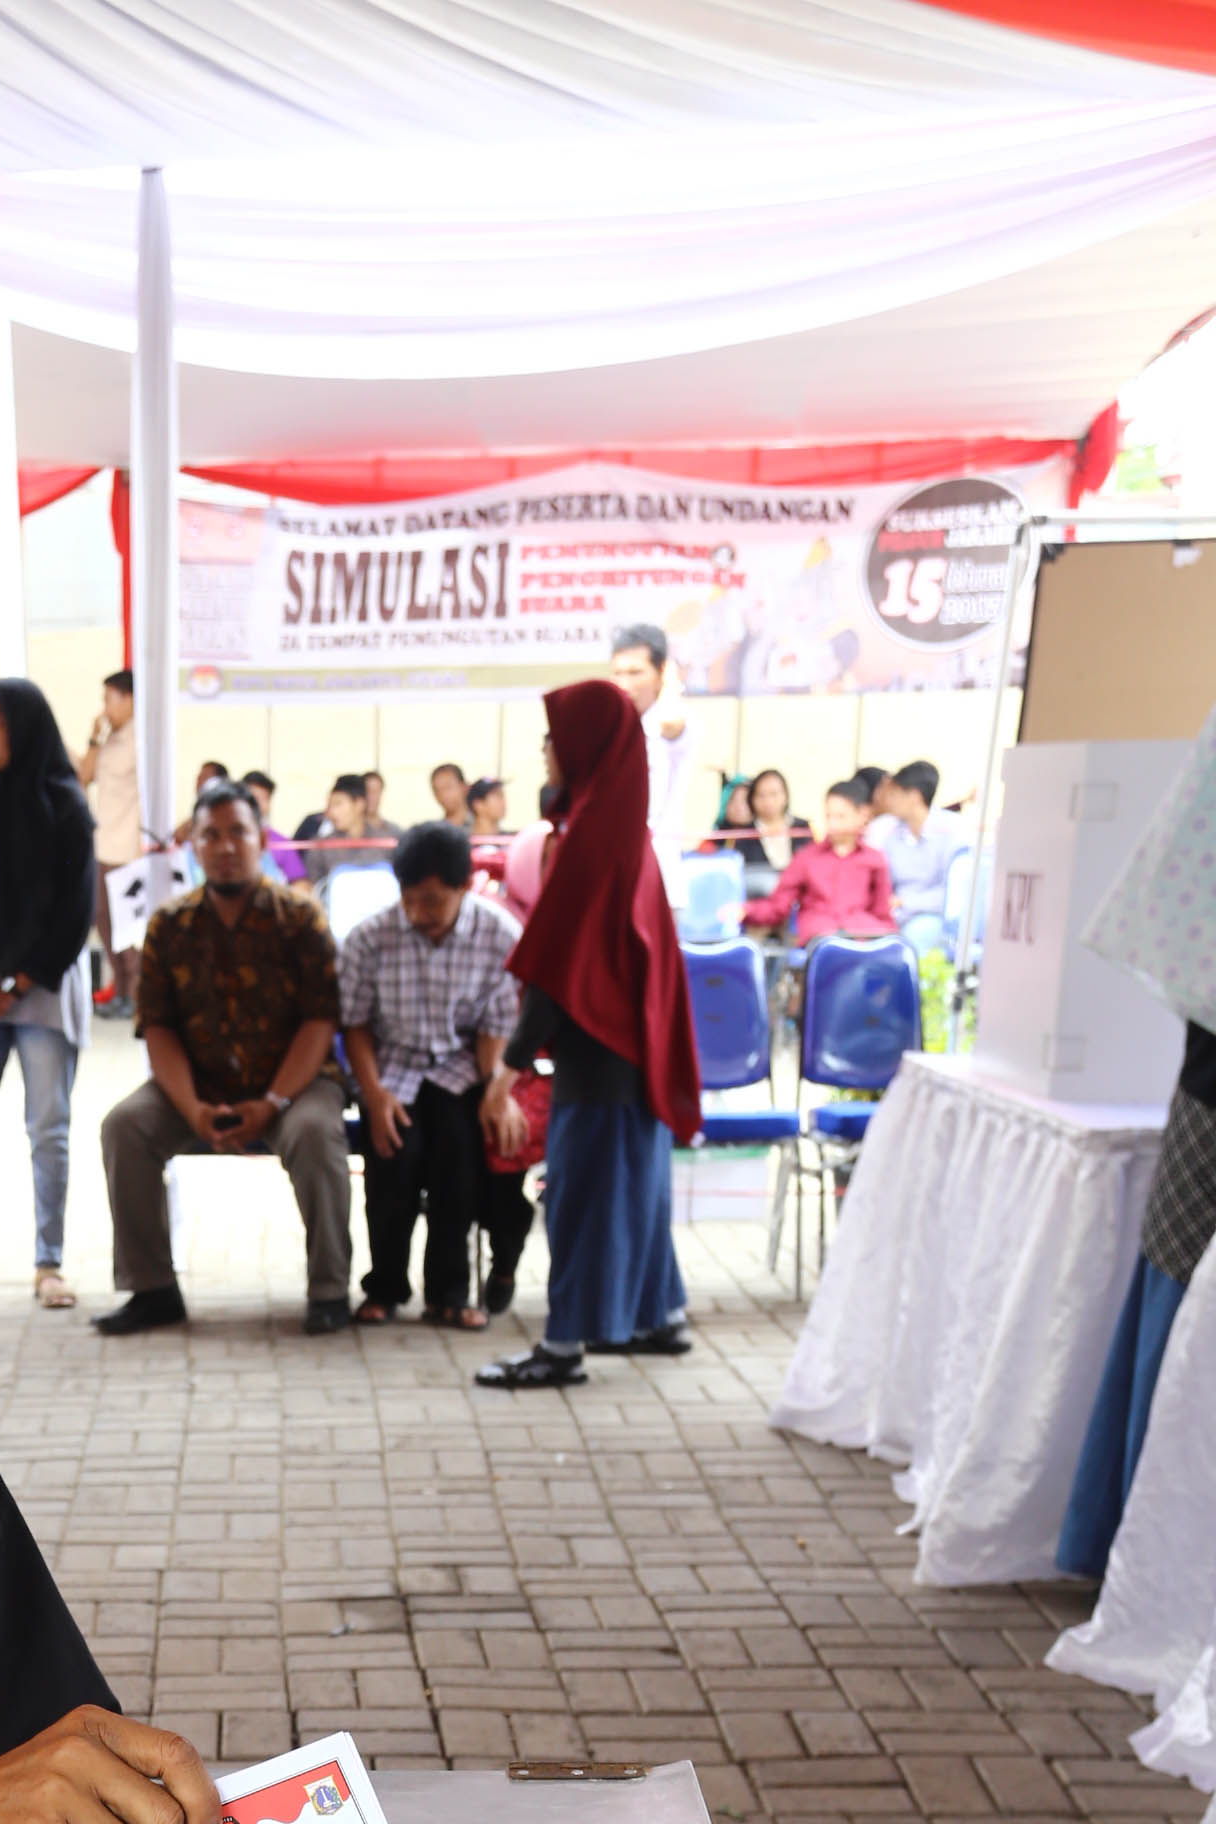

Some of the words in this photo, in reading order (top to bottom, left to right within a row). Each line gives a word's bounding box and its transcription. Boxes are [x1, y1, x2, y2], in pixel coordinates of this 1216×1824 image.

[404, 502, 510, 534] DATANG
[517, 494, 628, 523] PESERTA
[636, 496, 691, 522] DAN
[699, 497, 854, 523] UNDANGAN
[285, 541, 510, 624] SIMULASI
[878, 557, 947, 624] 15
